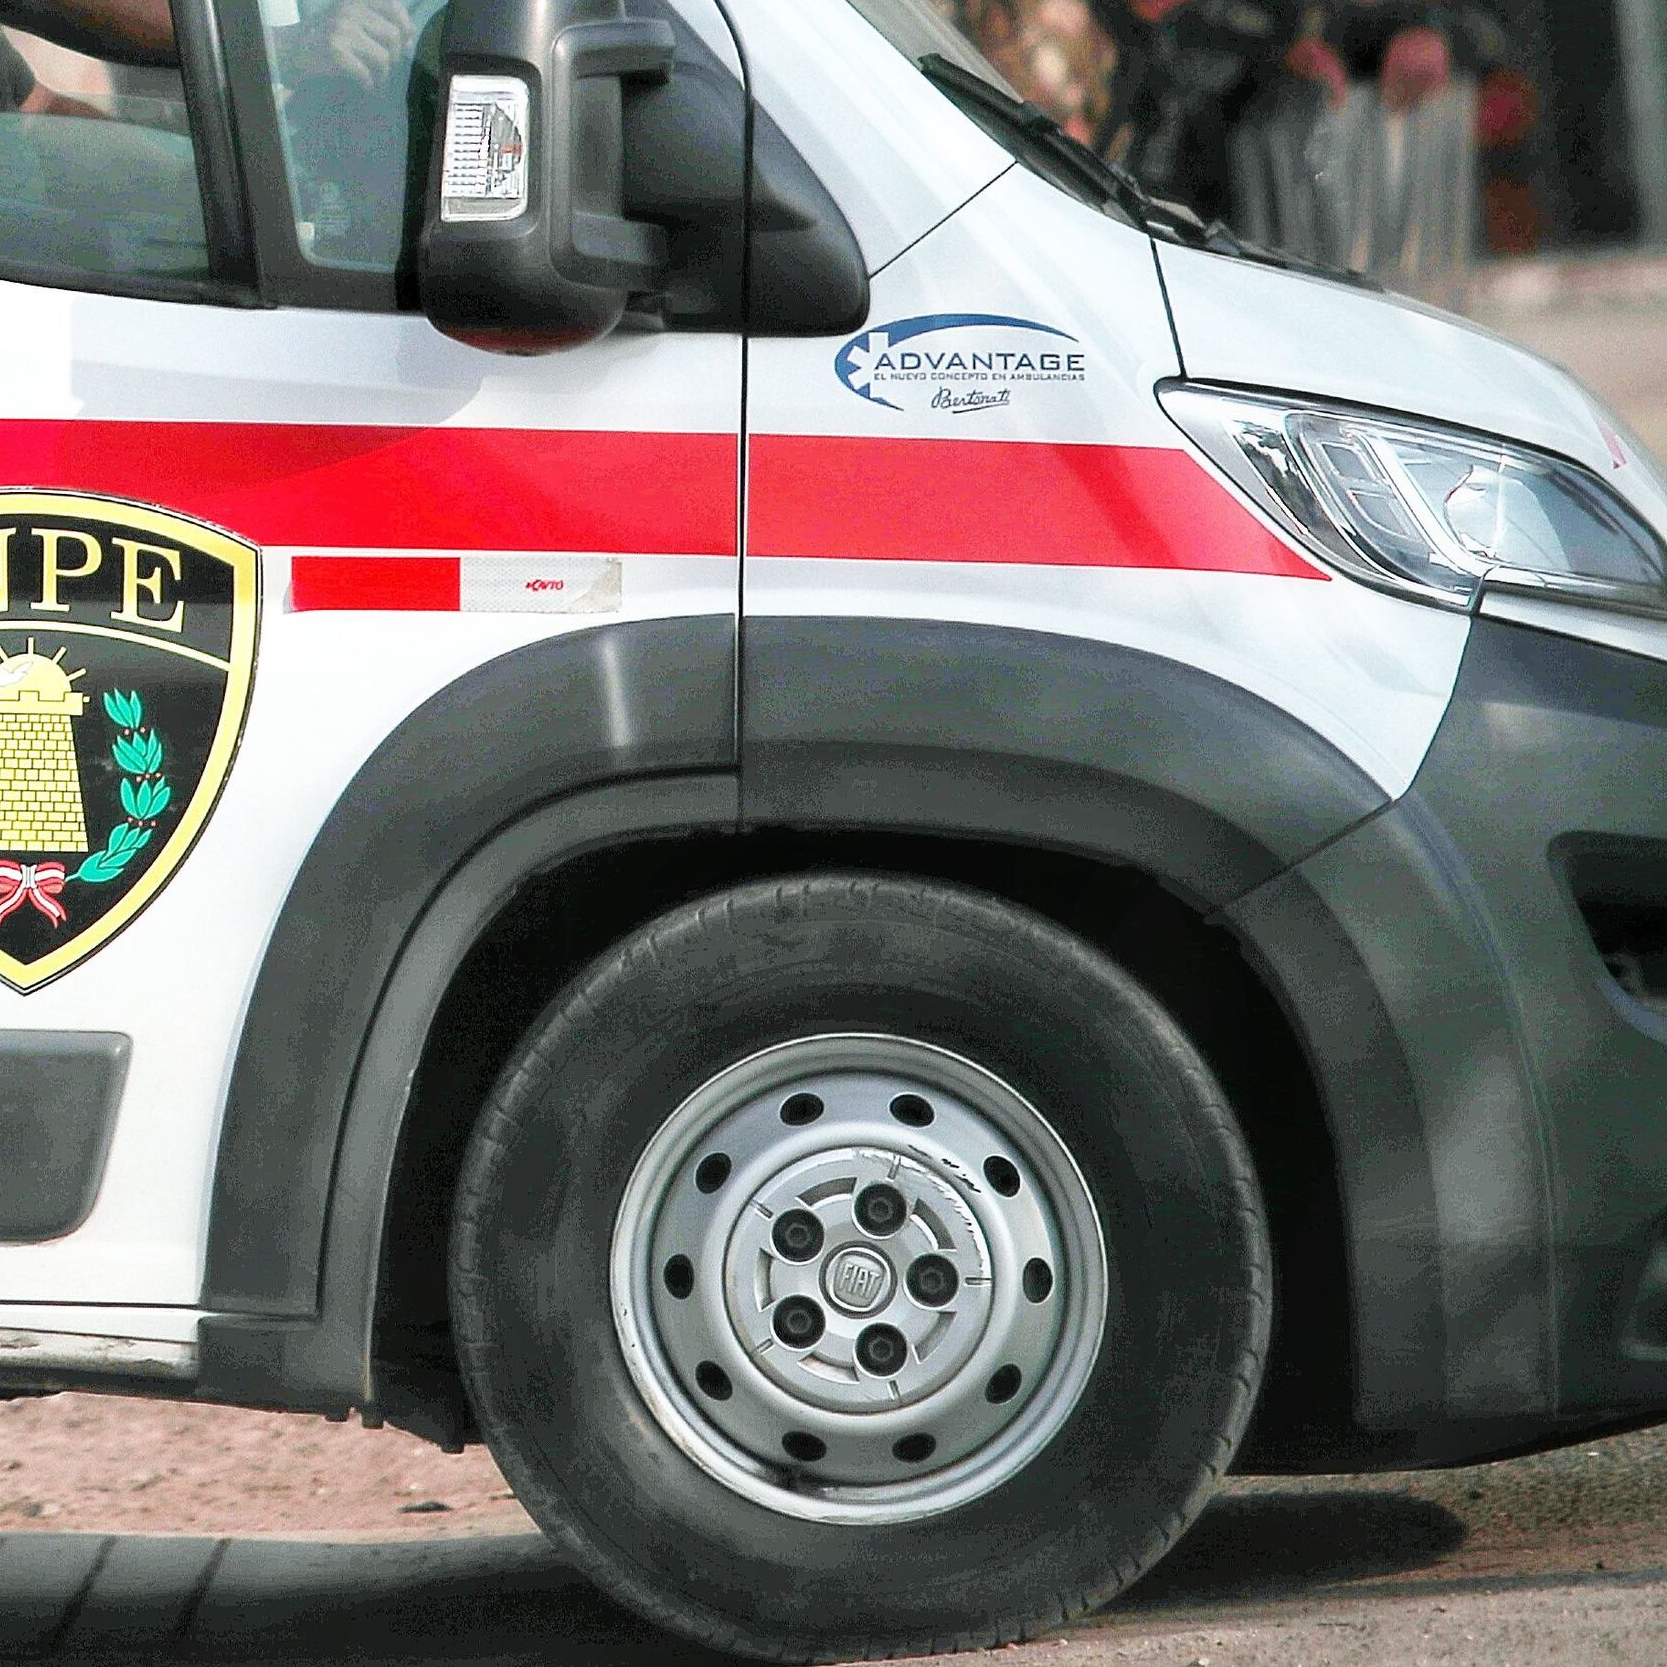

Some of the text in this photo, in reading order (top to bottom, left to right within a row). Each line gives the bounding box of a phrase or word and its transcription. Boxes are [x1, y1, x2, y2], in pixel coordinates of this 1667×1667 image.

[873, 352, 1085, 371] ADVANTAGE
[873, 373, 1085, 381] EL NUEVO CONCEPTO EN AMBULANCIAS
[839, 1262, 881, 1298] FIAT
